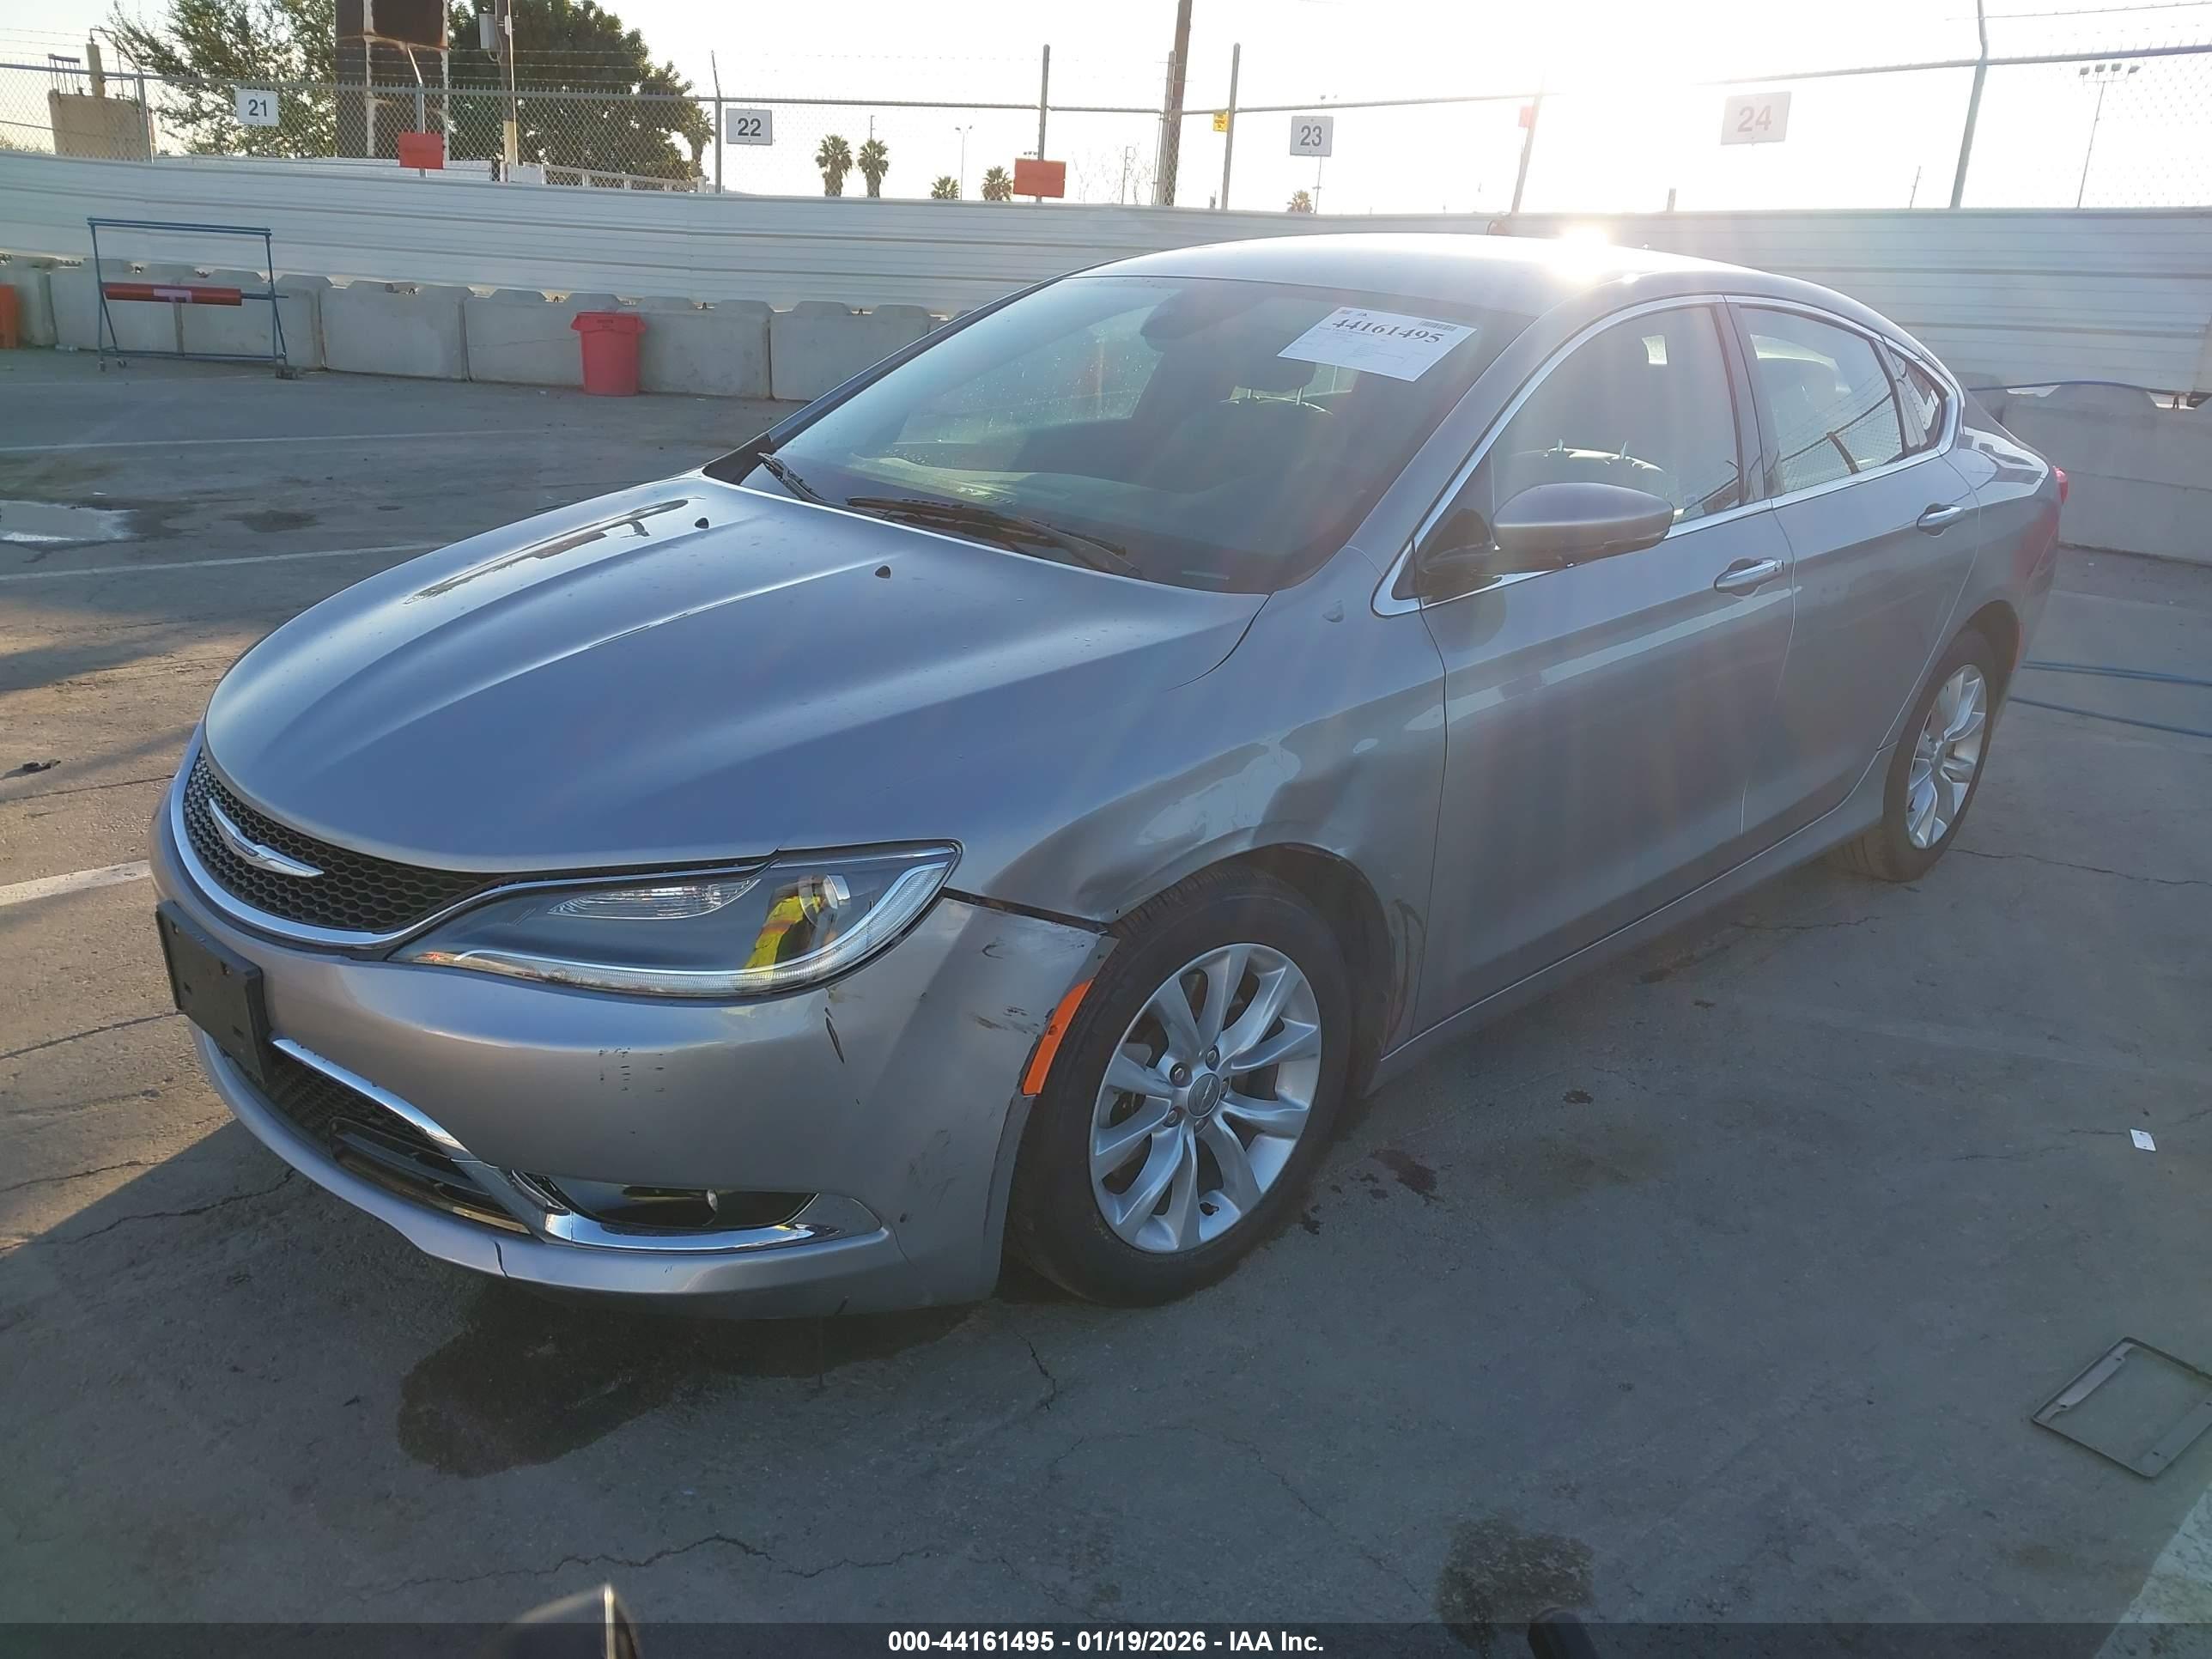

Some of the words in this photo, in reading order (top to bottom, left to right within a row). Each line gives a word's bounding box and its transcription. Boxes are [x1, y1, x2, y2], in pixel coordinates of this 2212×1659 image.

[248, 99, 267, 117] 21
[1737, 105, 1772, 132] 24
[737, 117, 762, 137] 22
[1299, 125, 1322, 147] 23
[1332, 318, 1444, 343] 44161495
